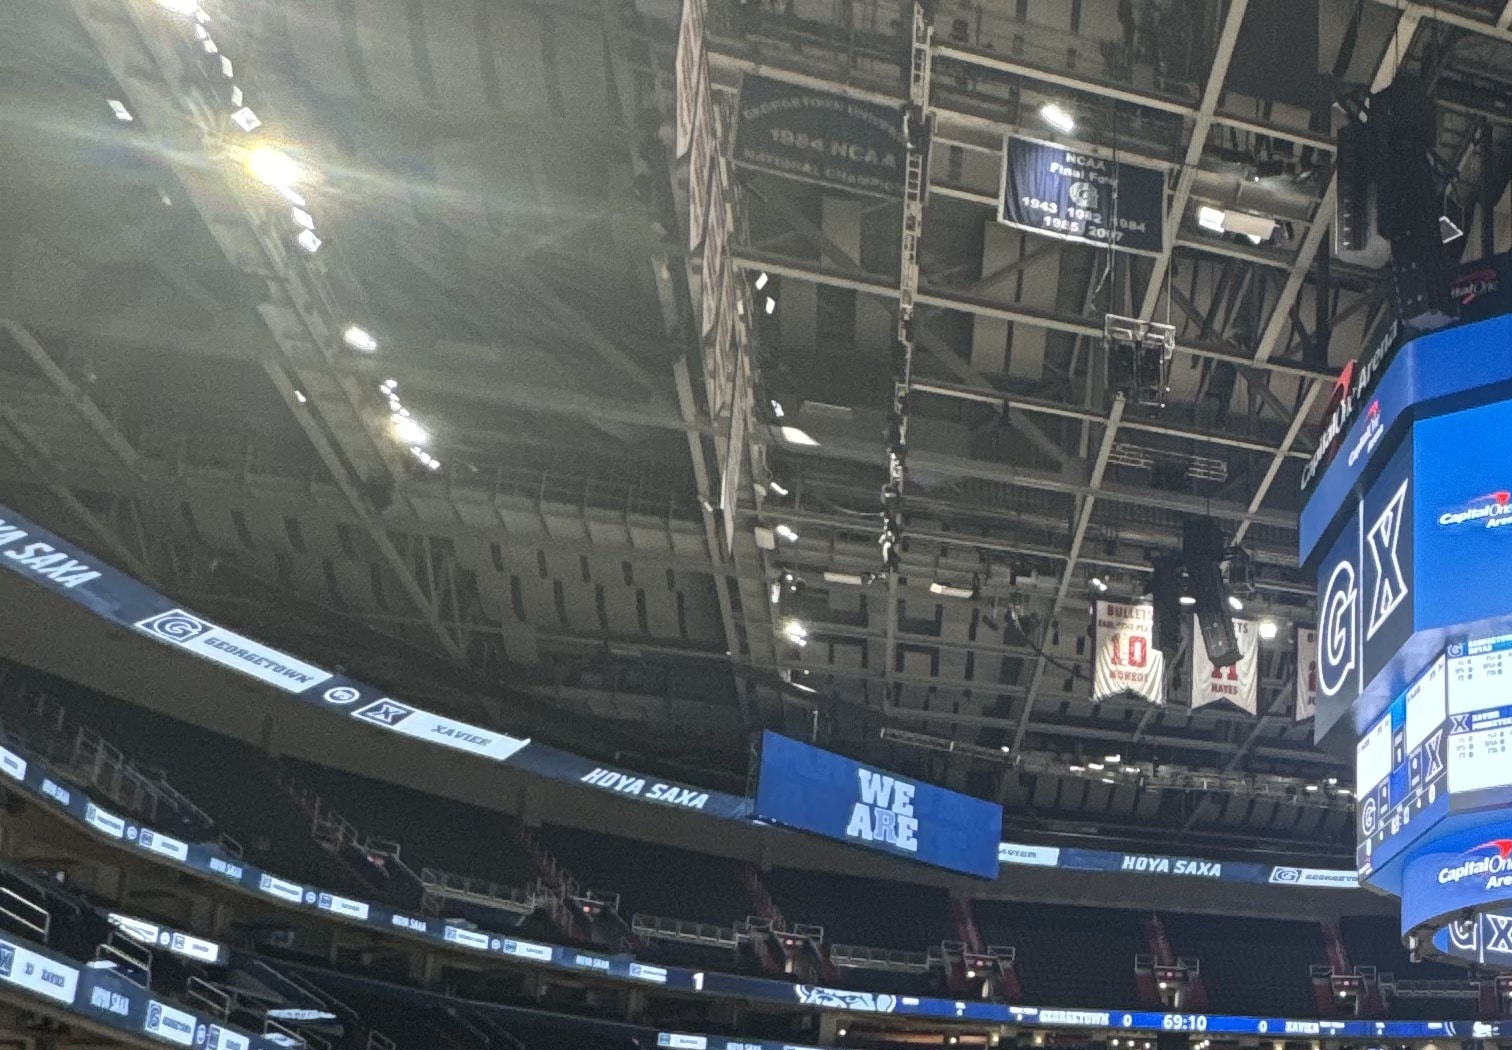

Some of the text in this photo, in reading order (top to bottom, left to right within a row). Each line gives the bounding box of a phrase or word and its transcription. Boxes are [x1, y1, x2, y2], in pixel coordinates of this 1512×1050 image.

[1050, 162, 1085, 180] Final
[1066, 153, 1105, 171] NCAA
[1022, 196, 1058, 214] 1943
[1043, 216, 1080, 232] 1985
[6, 541, 102, 588] SAXA
[1318, 477, 1409, 696] G X
[203, 636, 317, 684] GEORGETOWN
[1111, 635, 1147, 668] 10
[1211, 683, 1239, 695] HAYES
[431, 724, 493, 747] XAVIER
[581, 767, 712, 810] HOYA SAXA
[857, 768, 915, 818] WE
[846, 806, 919, 852] ARE
[1121, 855, 1222, 877] HOYA SAXA
[692, 972, 704, 991] 1
[1039, 1011, 1109, 1026] GEORGETOWN
[1122, 1012, 1132, 1027] 0
[1163, 1014, 1207, 1031] 69:10
[1258, 1019, 1268, 1033] 0
[1285, 1021, 1320, 1034] XAVIER
